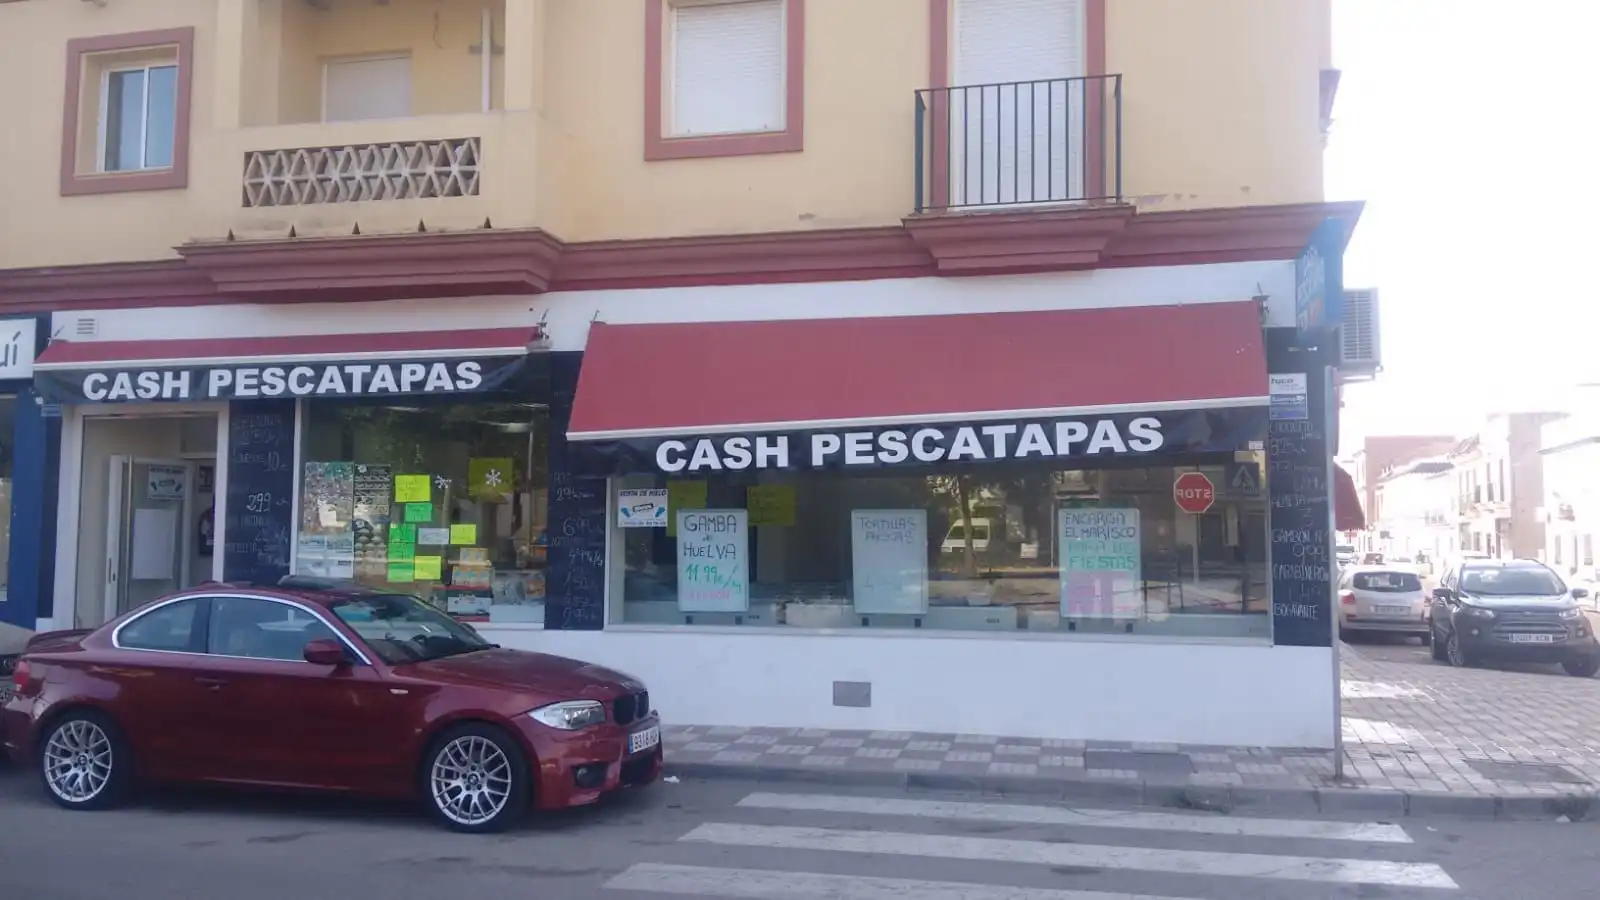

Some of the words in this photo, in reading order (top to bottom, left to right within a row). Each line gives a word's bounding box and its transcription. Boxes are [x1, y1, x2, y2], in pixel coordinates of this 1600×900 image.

[83, 370, 190, 401] CASH
[208, 361, 482, 397] PESCATAPAS
[656, 435, 789, 472] CASH
[811, 417, 1163, 466] PESCATAPAS
[684, 514, 737, 533] GAMBA
[1065, 511, 1126, 525] ENCARGA
[1065, 527, 1077, 538] EL
[1081, 526, 1136, 540] MARISCO
[683, 542, 737, 560] HUELVA
[1070, 556, 1137, 570] FIESTAS
